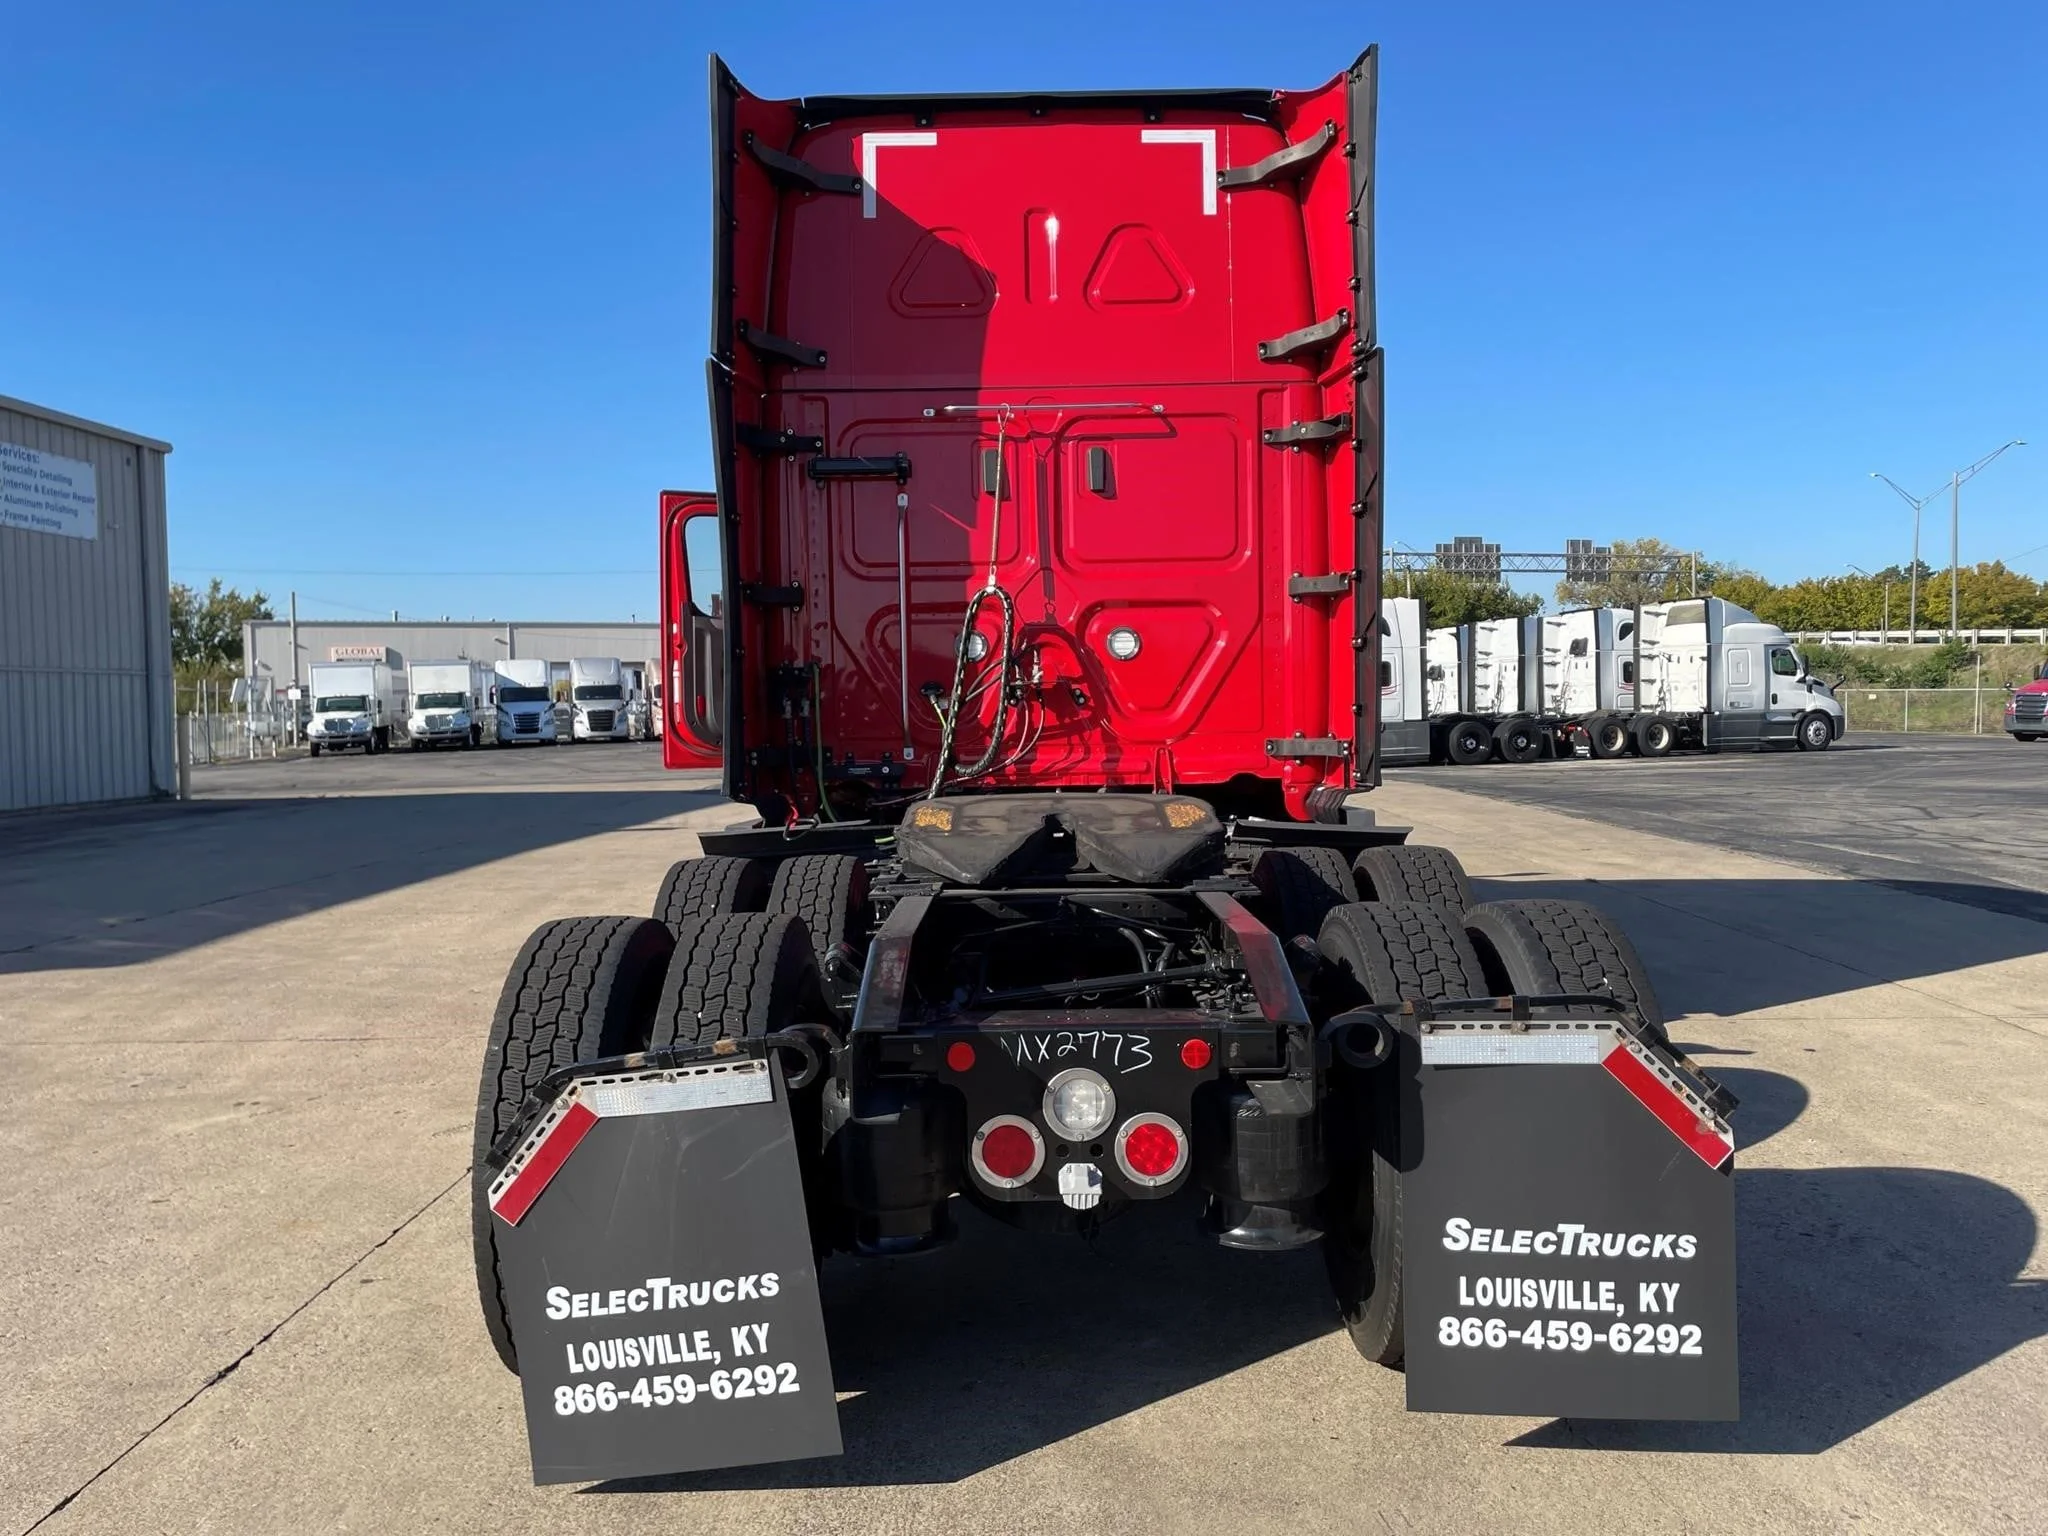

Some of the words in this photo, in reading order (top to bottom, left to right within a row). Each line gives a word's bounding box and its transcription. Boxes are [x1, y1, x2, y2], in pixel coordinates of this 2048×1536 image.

[2, 461, 37, 478] Specialty
[40, 470, 72, 486] Detailing
[3, 477, 32, 492] Interior
[34, 483, 39, 493] &
[42, 485, 70, 499] Exterior
[4, 493, 43, 509] Aluminum
[45, 501, 78, 518] Polishing
[5, 508, 28, 521] Frame
[31, 514, 62, 530] Painting
[335, 647, 381, 656] GLOBAL
[1459, 1276, 1625, 1318] LOUISVILLE,
[1639, 1282, 1681, 1313] KY
[566, 1329, 722, 1374] LOUISVILLE,
[730, 1322, 770, 1357] KY
[1438, 1316, 1703, 1355] 866-459-6292
[553, 1362, 801, 1416] 866-459-6292
